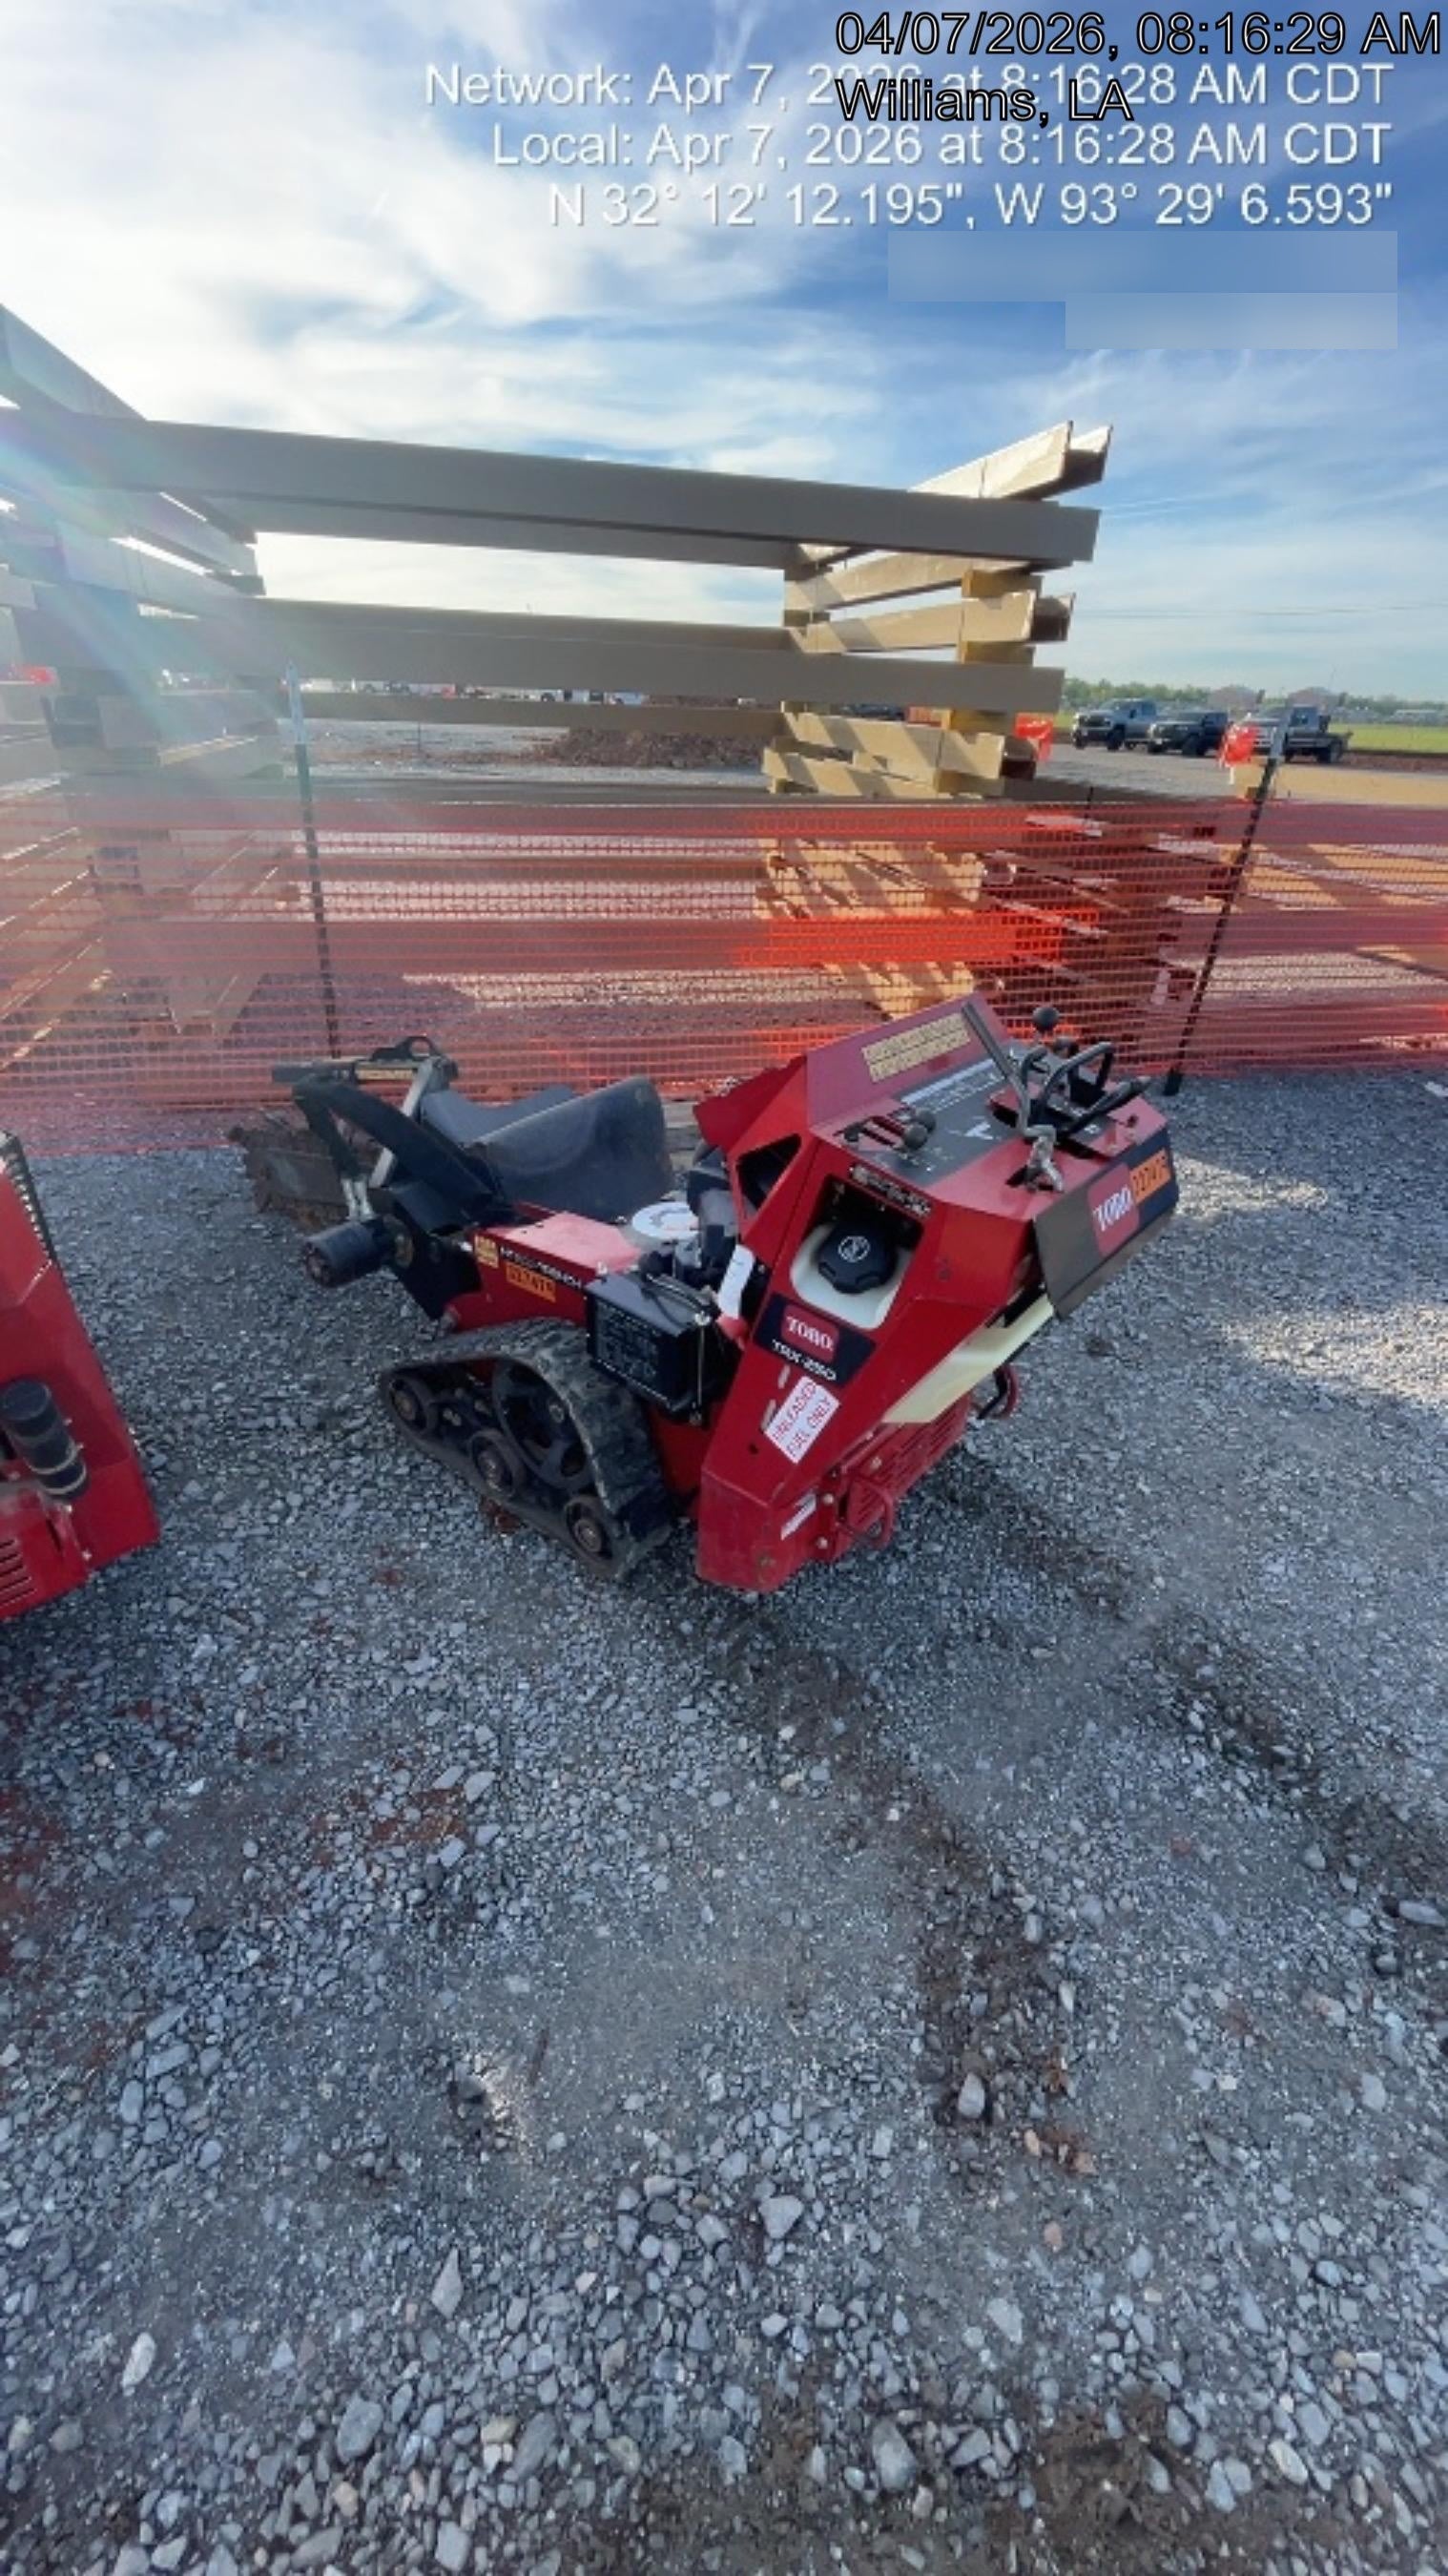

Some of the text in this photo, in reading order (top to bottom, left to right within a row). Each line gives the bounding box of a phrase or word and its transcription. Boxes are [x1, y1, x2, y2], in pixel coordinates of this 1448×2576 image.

[1091, 1184, 1132, 1232] TORO
[784, 1315, 835, 1352] TORO
[806, 1396, 831, 1429] ONLY
